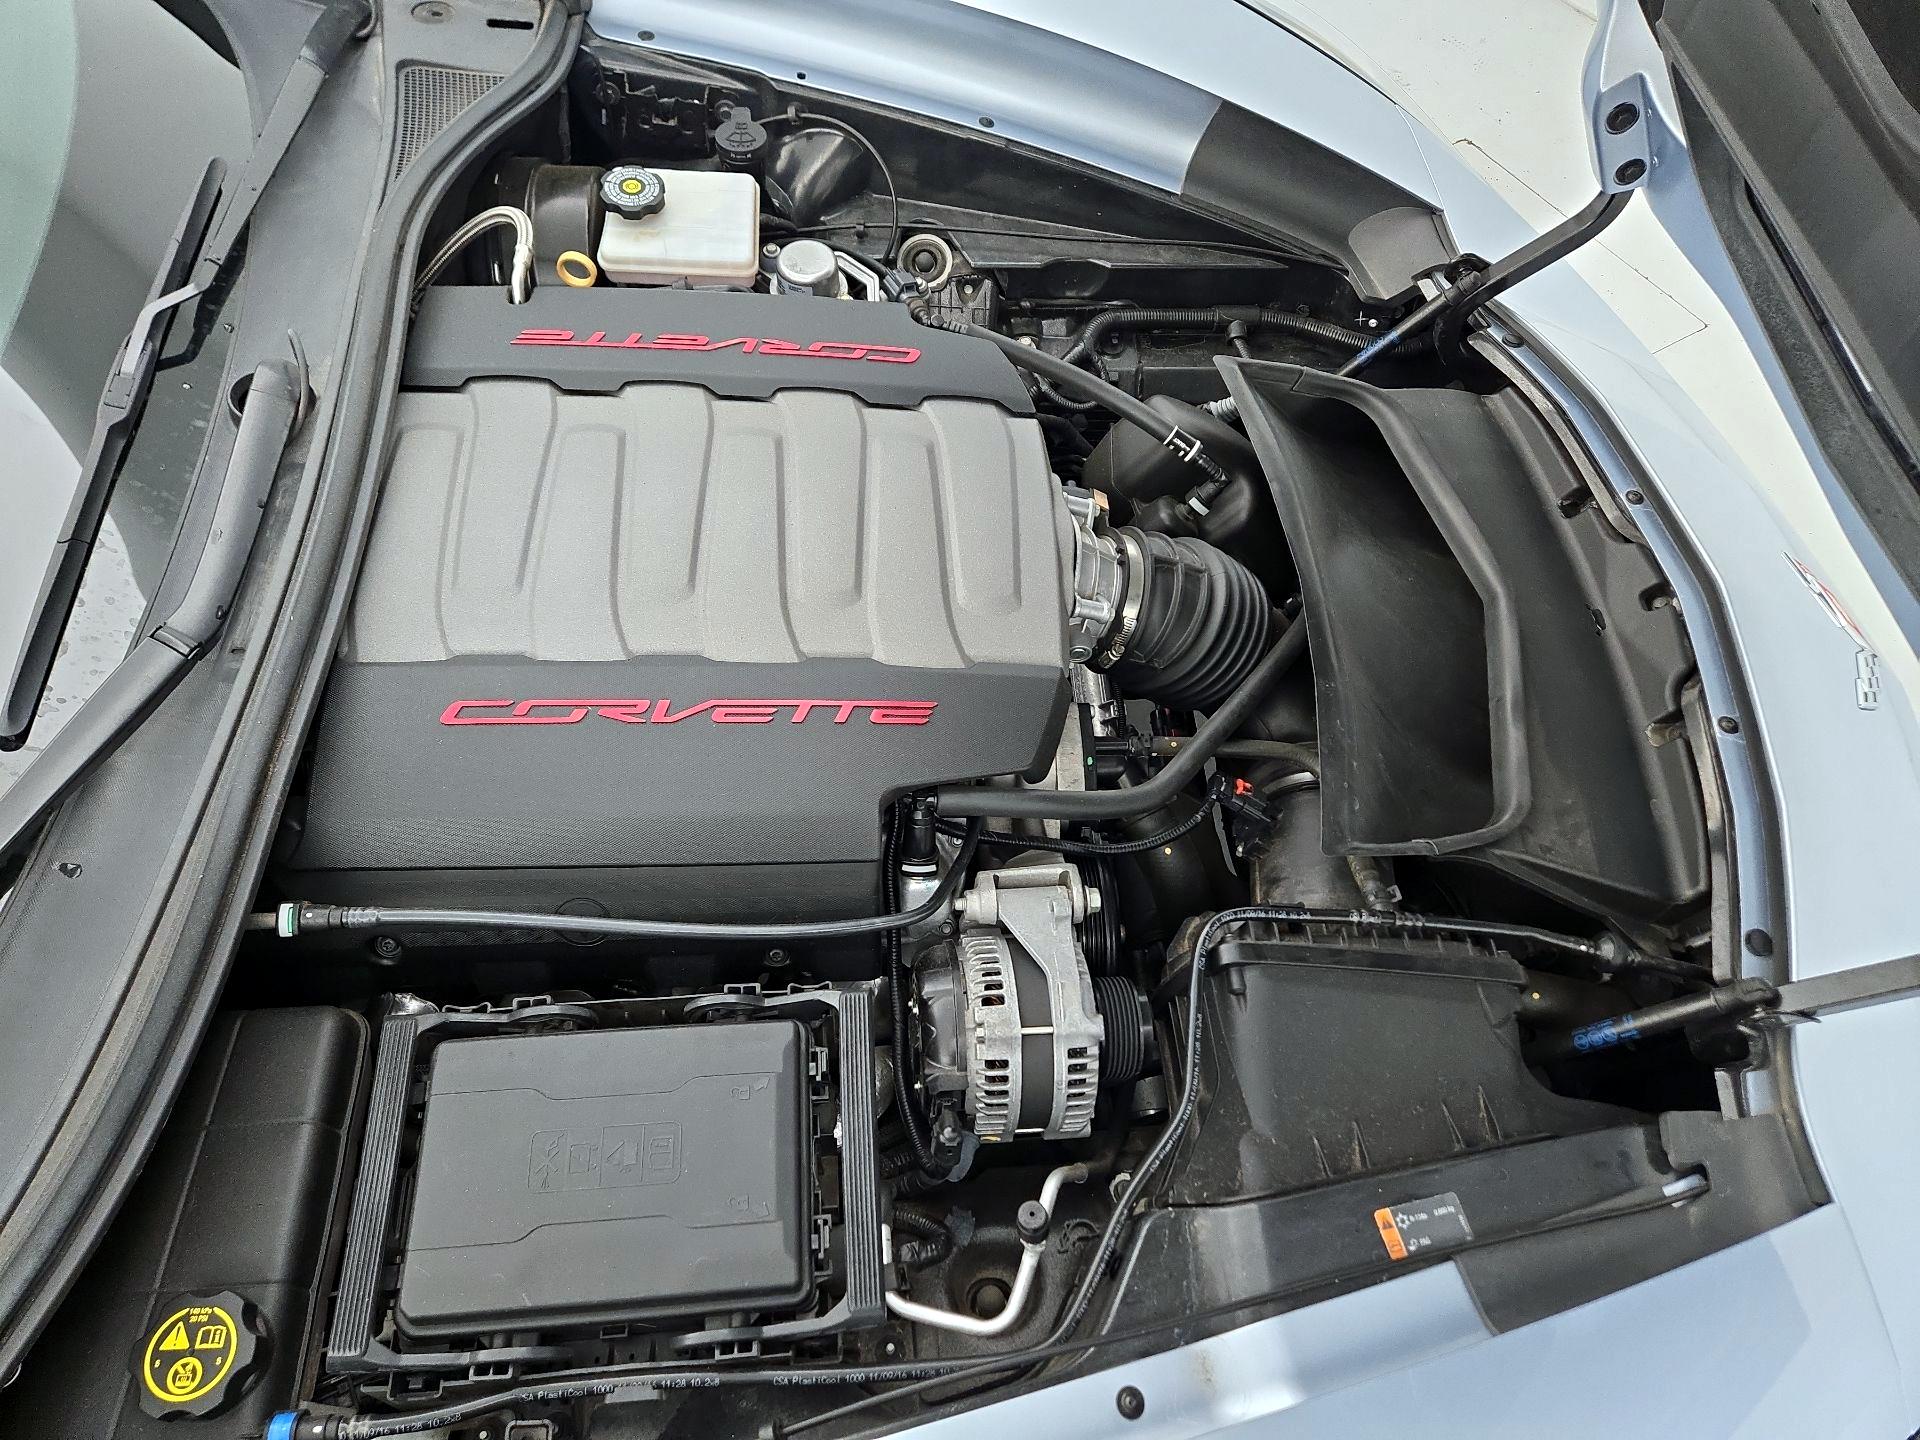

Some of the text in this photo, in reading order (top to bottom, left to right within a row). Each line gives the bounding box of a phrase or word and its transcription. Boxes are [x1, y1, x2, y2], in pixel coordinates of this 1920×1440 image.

[510, 329, 921, 363] CORVETTE
[439, 699, 938, 725] CORVETTE
[189, 1307, 200, 1315] 140
[188, 1315, 209, 1323] 20 PSI
[661, 1378, 686, 1389] 11:28
[792, 1374, 840, 1386] PlastiCool
[845, 1373, 865, 1383] 1000
[538, 1387, 588, 1400] PlastiCool
[394, 1421, 423, 1434] 11:28
